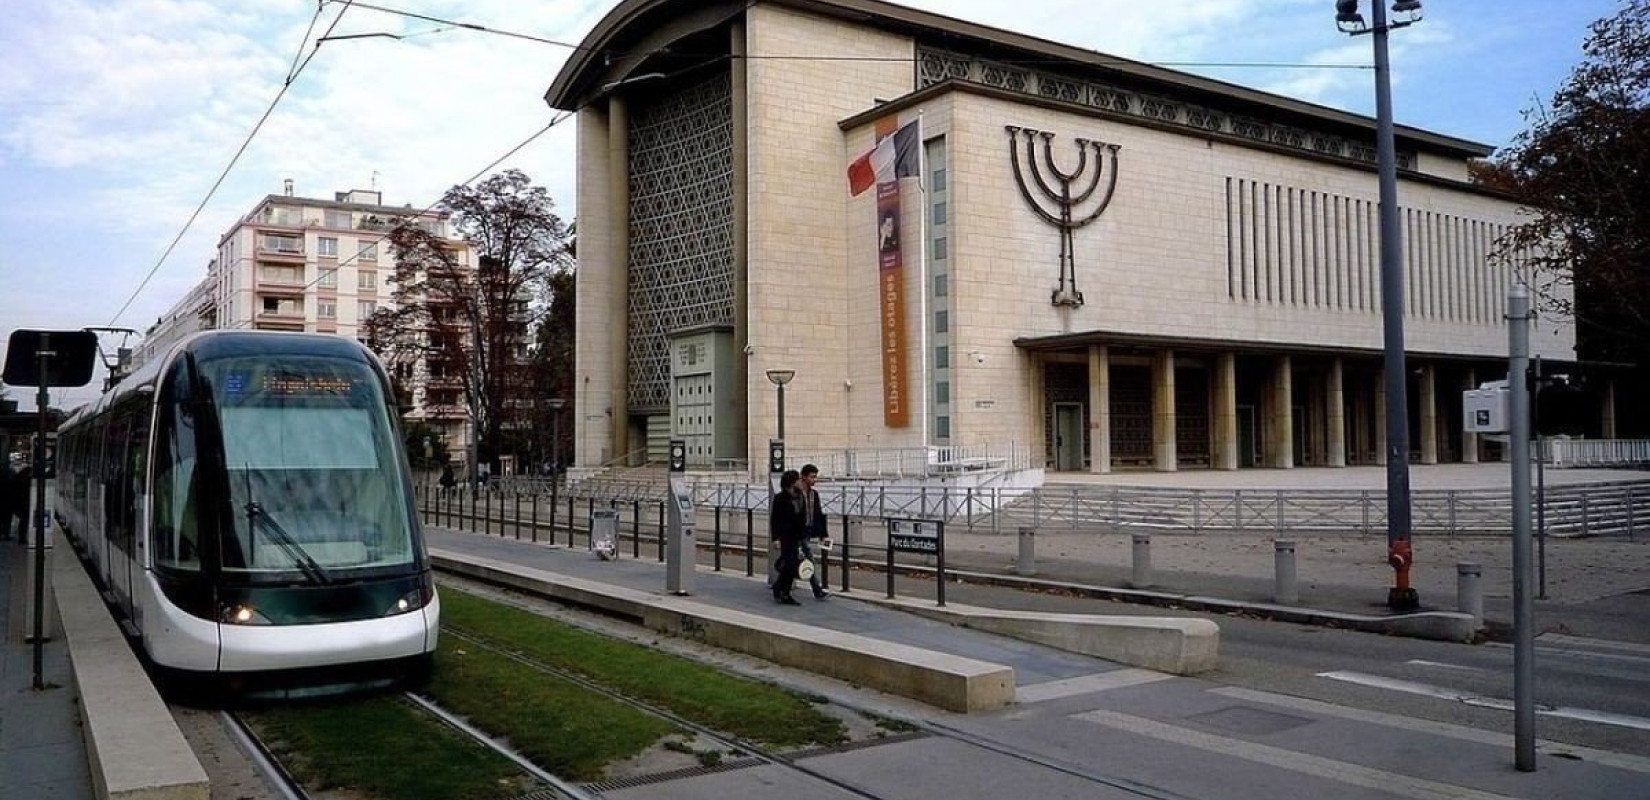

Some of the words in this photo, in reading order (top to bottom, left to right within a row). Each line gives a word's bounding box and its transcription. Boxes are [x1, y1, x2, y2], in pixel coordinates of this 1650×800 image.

[886, 274, 897, 327] otages
[887, 331, 896, 353] les
[888, 356, 899, 414] Libérez
